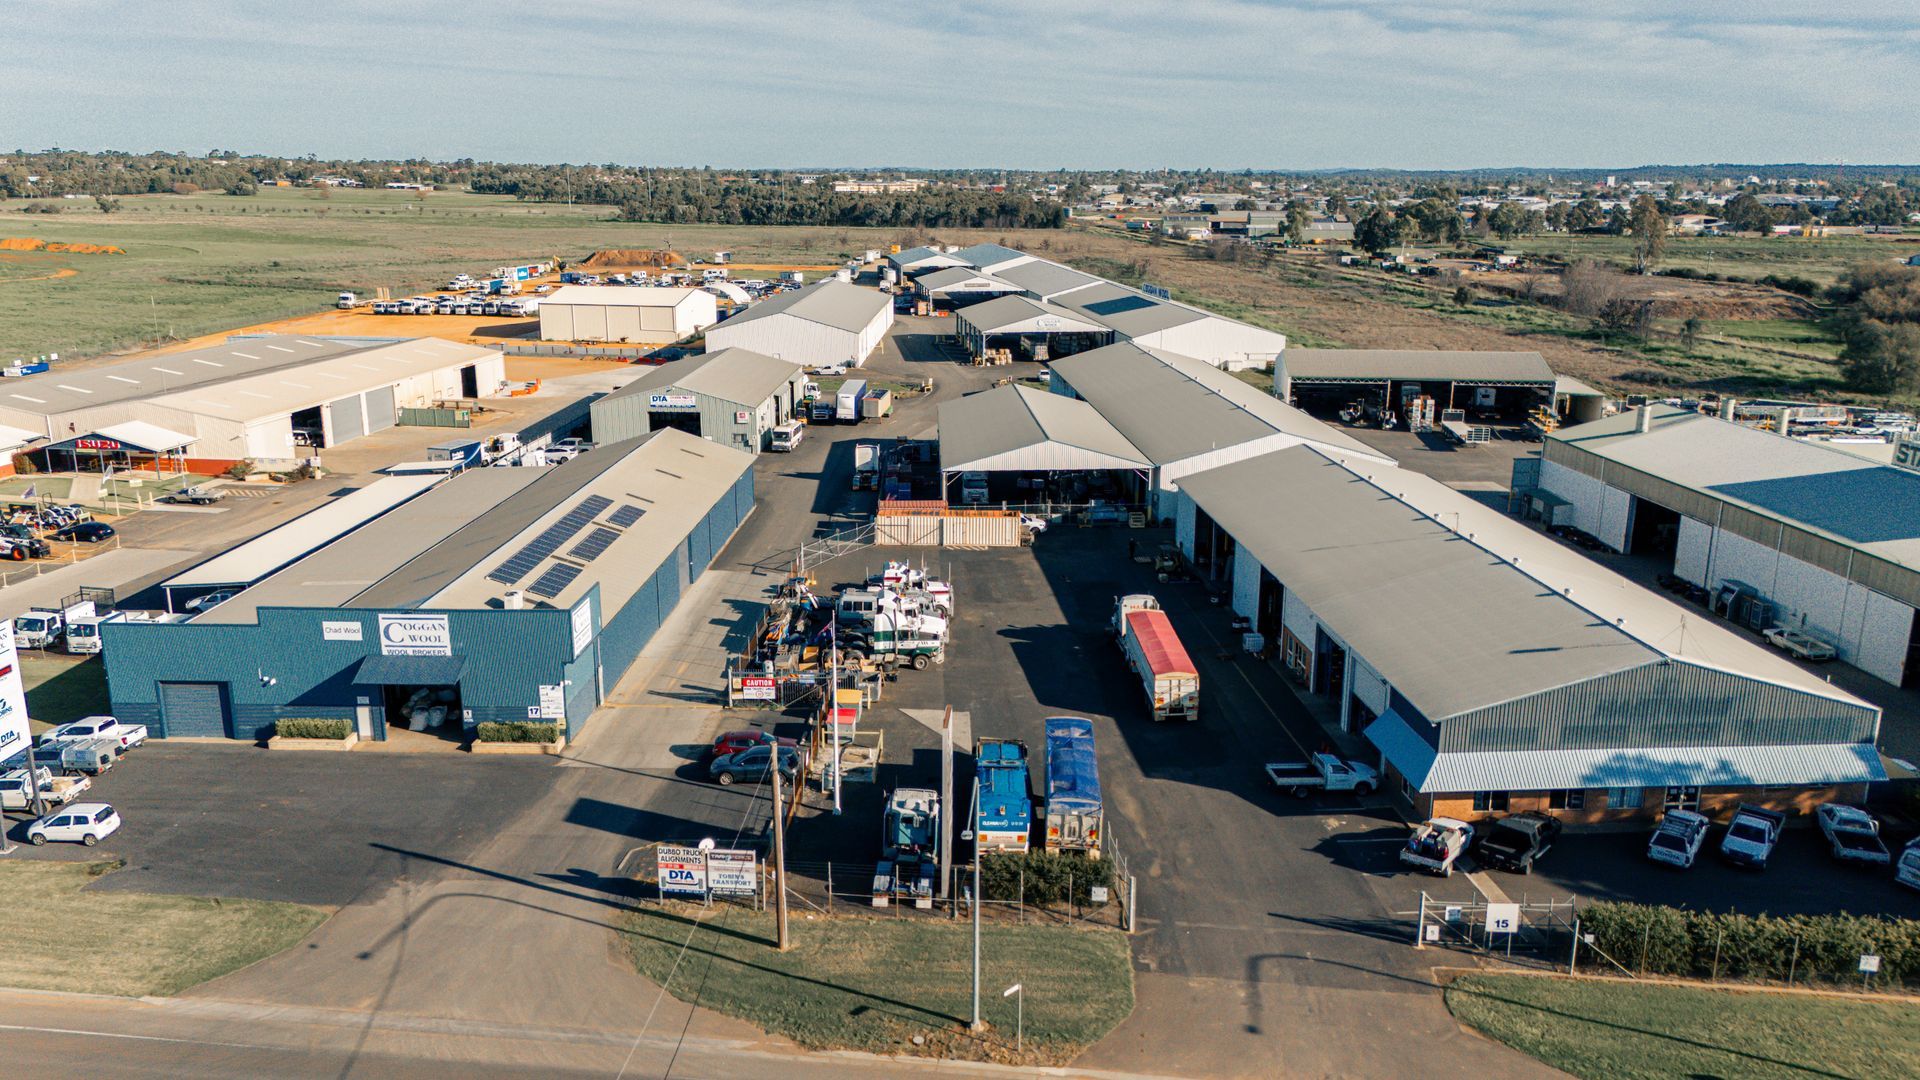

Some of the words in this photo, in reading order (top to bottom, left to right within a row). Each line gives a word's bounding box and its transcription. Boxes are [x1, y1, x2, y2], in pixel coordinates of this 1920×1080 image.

[77, 440, 120, 449] ISUZU
[383, 622, 446, 643] COGGAN
[408, 634, 445, 643] WOOL
[746, 679, 773, 687] CAUTION
[529, 707, 539, 715] 17
[1, 730, 15, 743] DTA
[658, 848, 681, 856] DUBBO
[682, 849, 703, 857] TRUCK
[660, 856, 702, 864] ALIGNMENTS
[669, 870, 694, 880] DTA
[1495, 919, 1509, 928] 15
